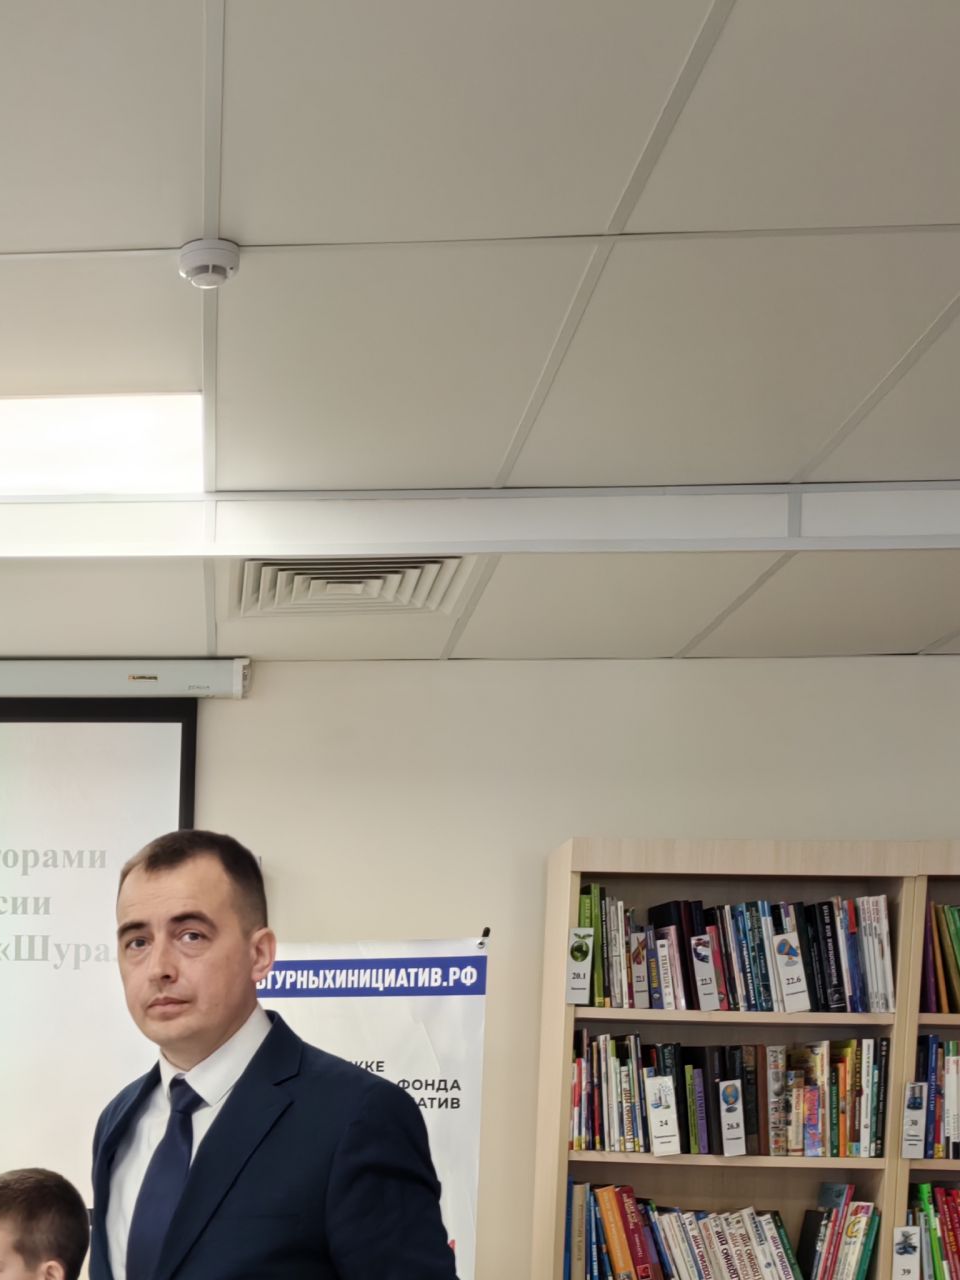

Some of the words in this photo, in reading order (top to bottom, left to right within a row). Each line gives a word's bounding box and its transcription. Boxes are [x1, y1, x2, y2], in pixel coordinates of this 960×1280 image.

[571, 972, 586, 980] 20.1
[784, 976, 802, 986] 22.6
[397, 1079, 462, 1093] ФОНДА
[901, 1268, 911, 1276] 39
